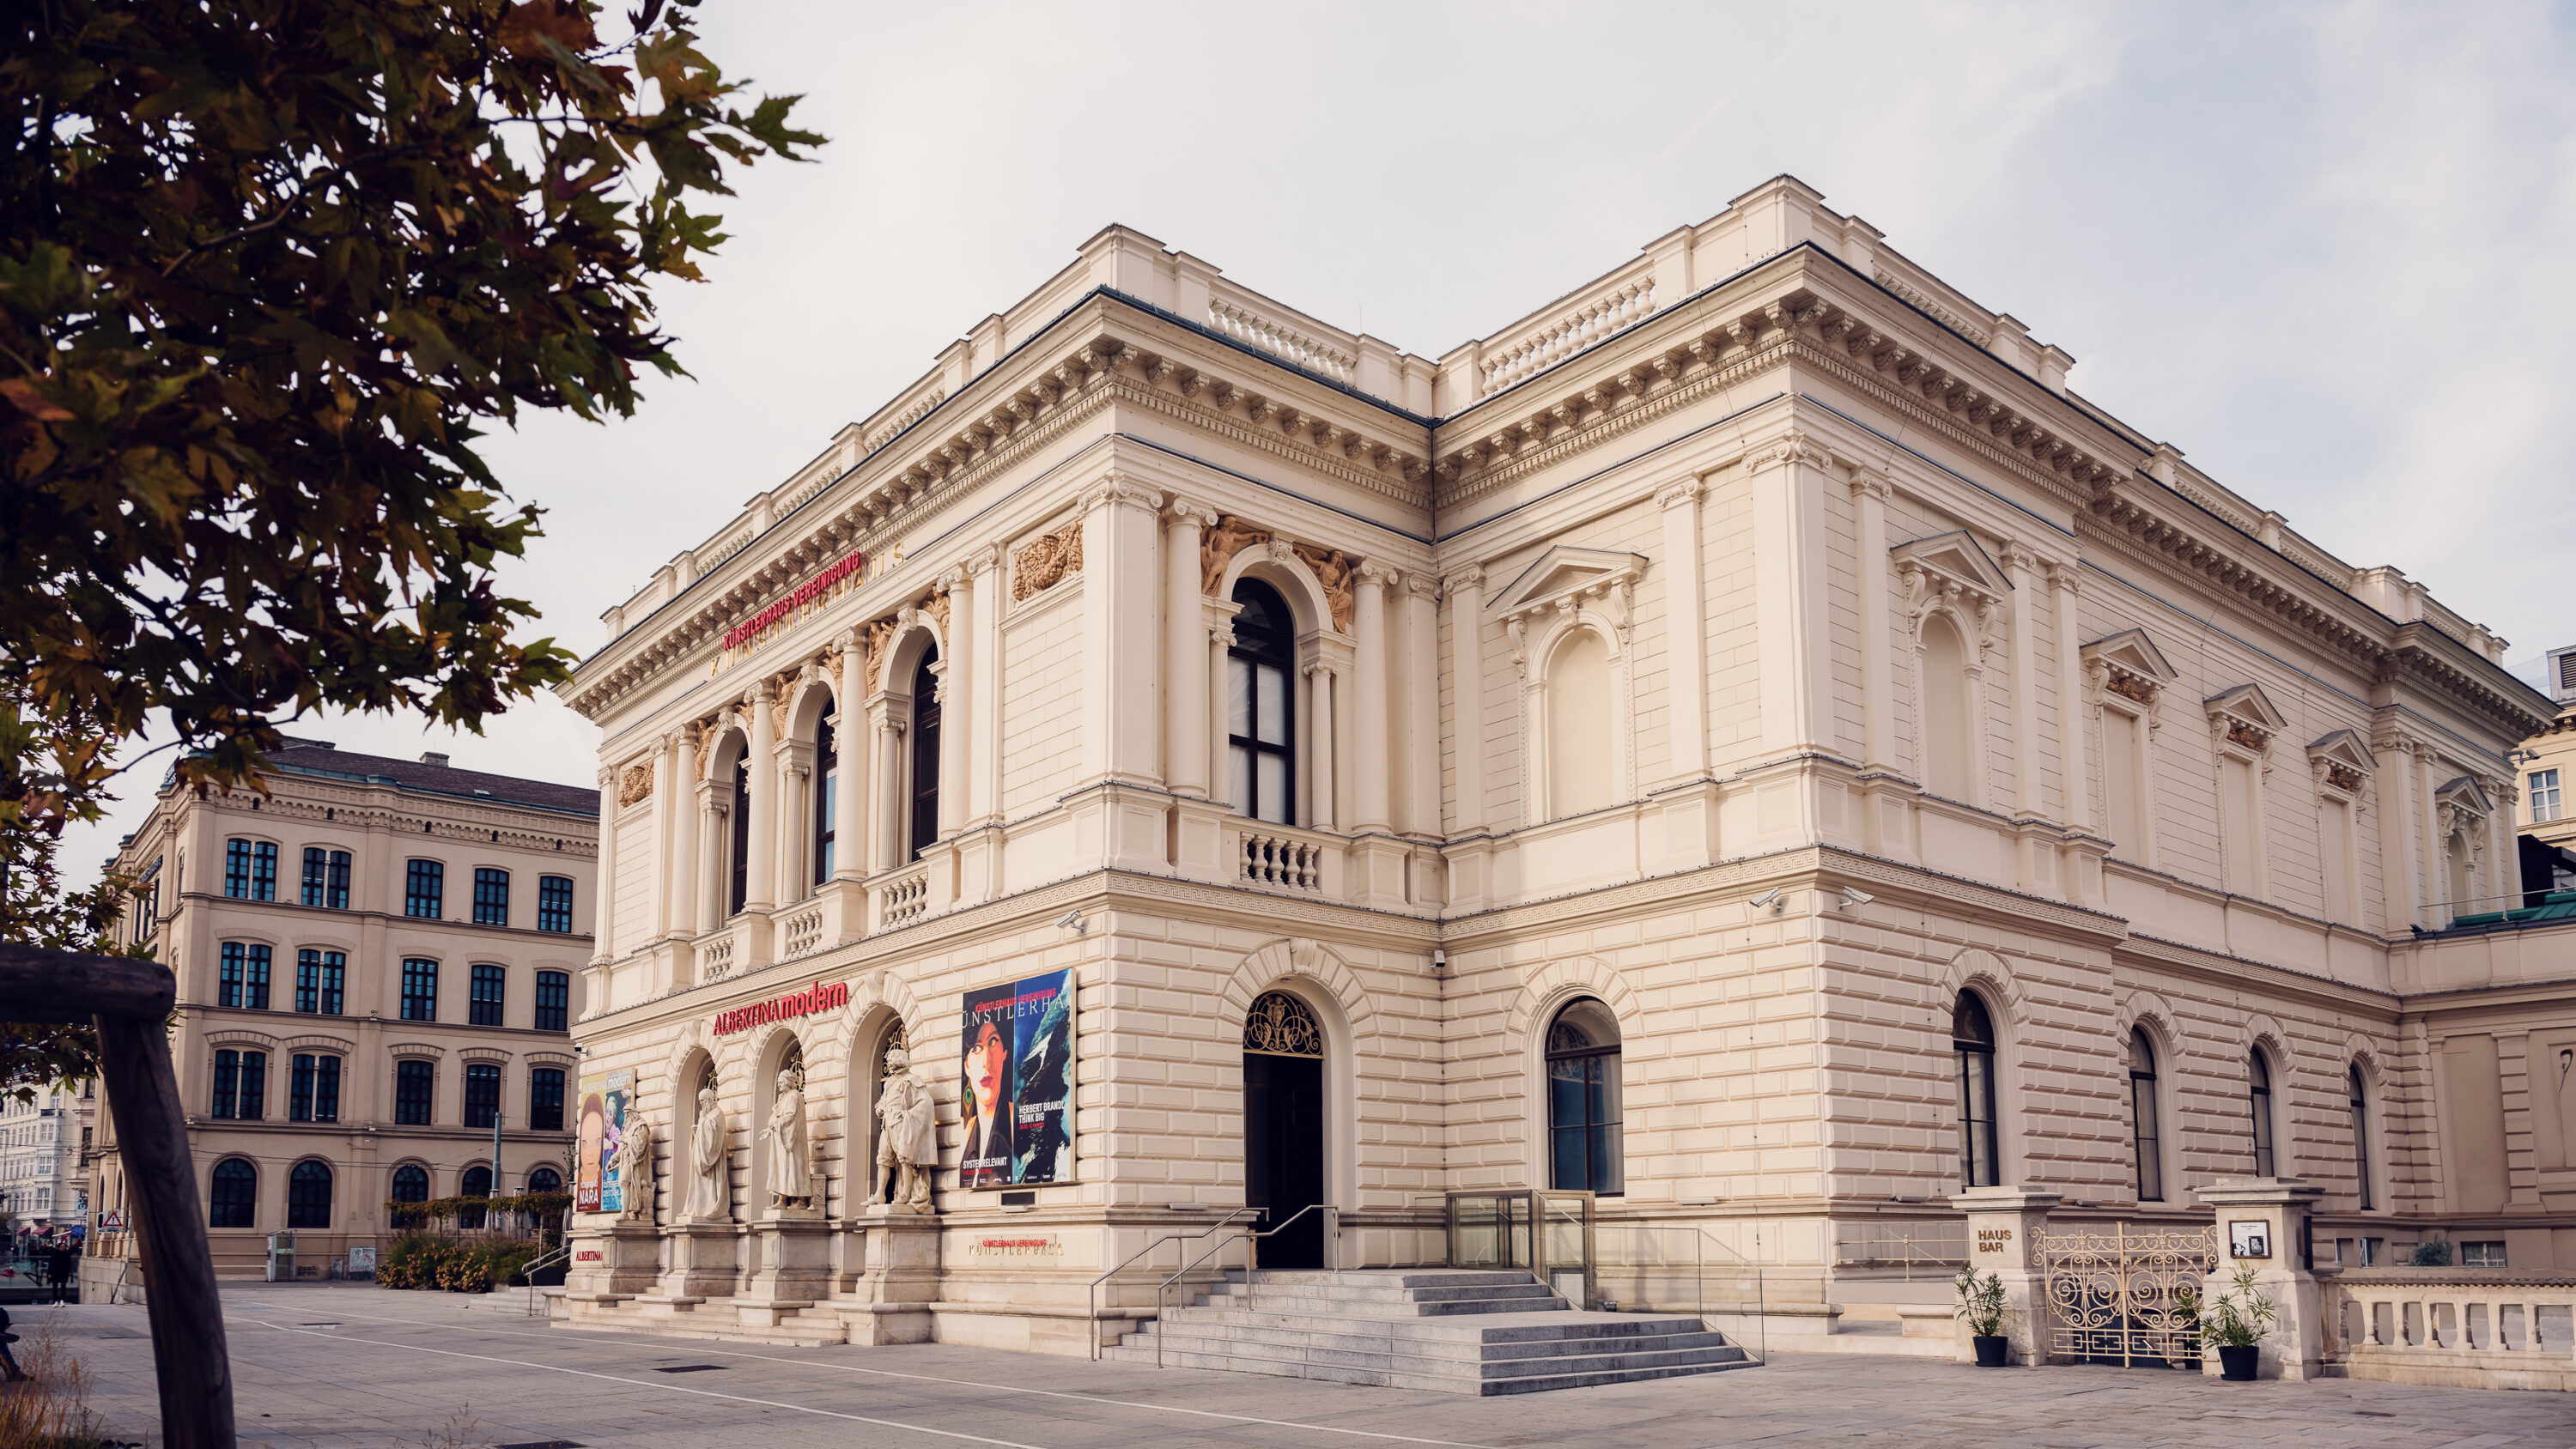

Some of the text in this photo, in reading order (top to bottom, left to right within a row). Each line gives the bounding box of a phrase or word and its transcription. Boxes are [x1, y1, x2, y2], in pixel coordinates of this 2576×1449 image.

[724, 551, 861, 652] KÜNSTLERHAUS VEREINIGUNG
[975, 987, 1056, 1014] KÜNSTLERHAUS VEREINIGUNG
[1018, 1100, 1065, 1114] HERBERT BRANDL
[1018, 1112, 1044, 1124] THINK BIG
[579, 1189, 598, 1204] NARA
[1978, 1229, 2012, 1240] HAUS
[1979, 1242, 2003, 1252] BAR
[576, 1251, 601, 1262] ALBERTINA
